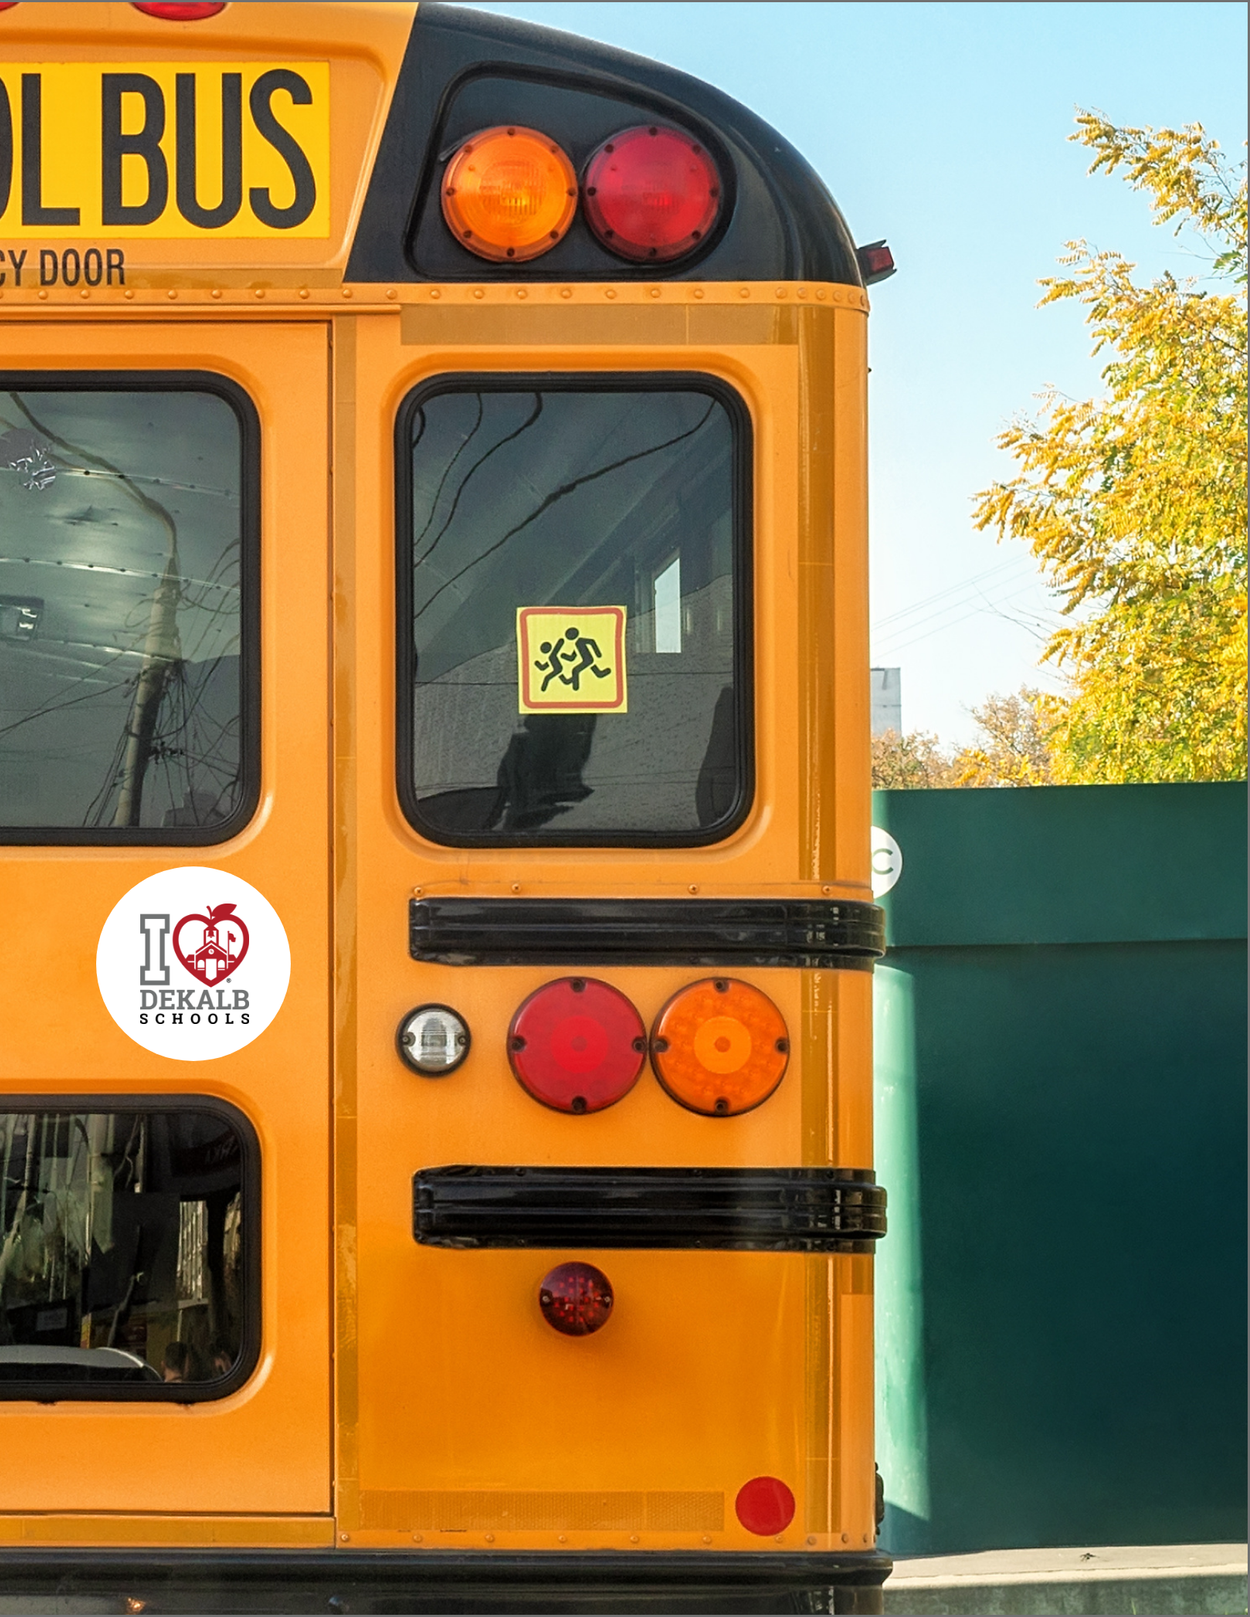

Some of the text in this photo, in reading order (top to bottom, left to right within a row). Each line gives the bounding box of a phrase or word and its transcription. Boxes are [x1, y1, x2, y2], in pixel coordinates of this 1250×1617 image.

[101, 68, 317, 230] BUS
[40, 248, 125, 287] DOOR
[139, 913, 170, 986] I
[139, 989, 250, 1010] DEKALB
[139, 1012, 250, 1025] SCHOOLS
